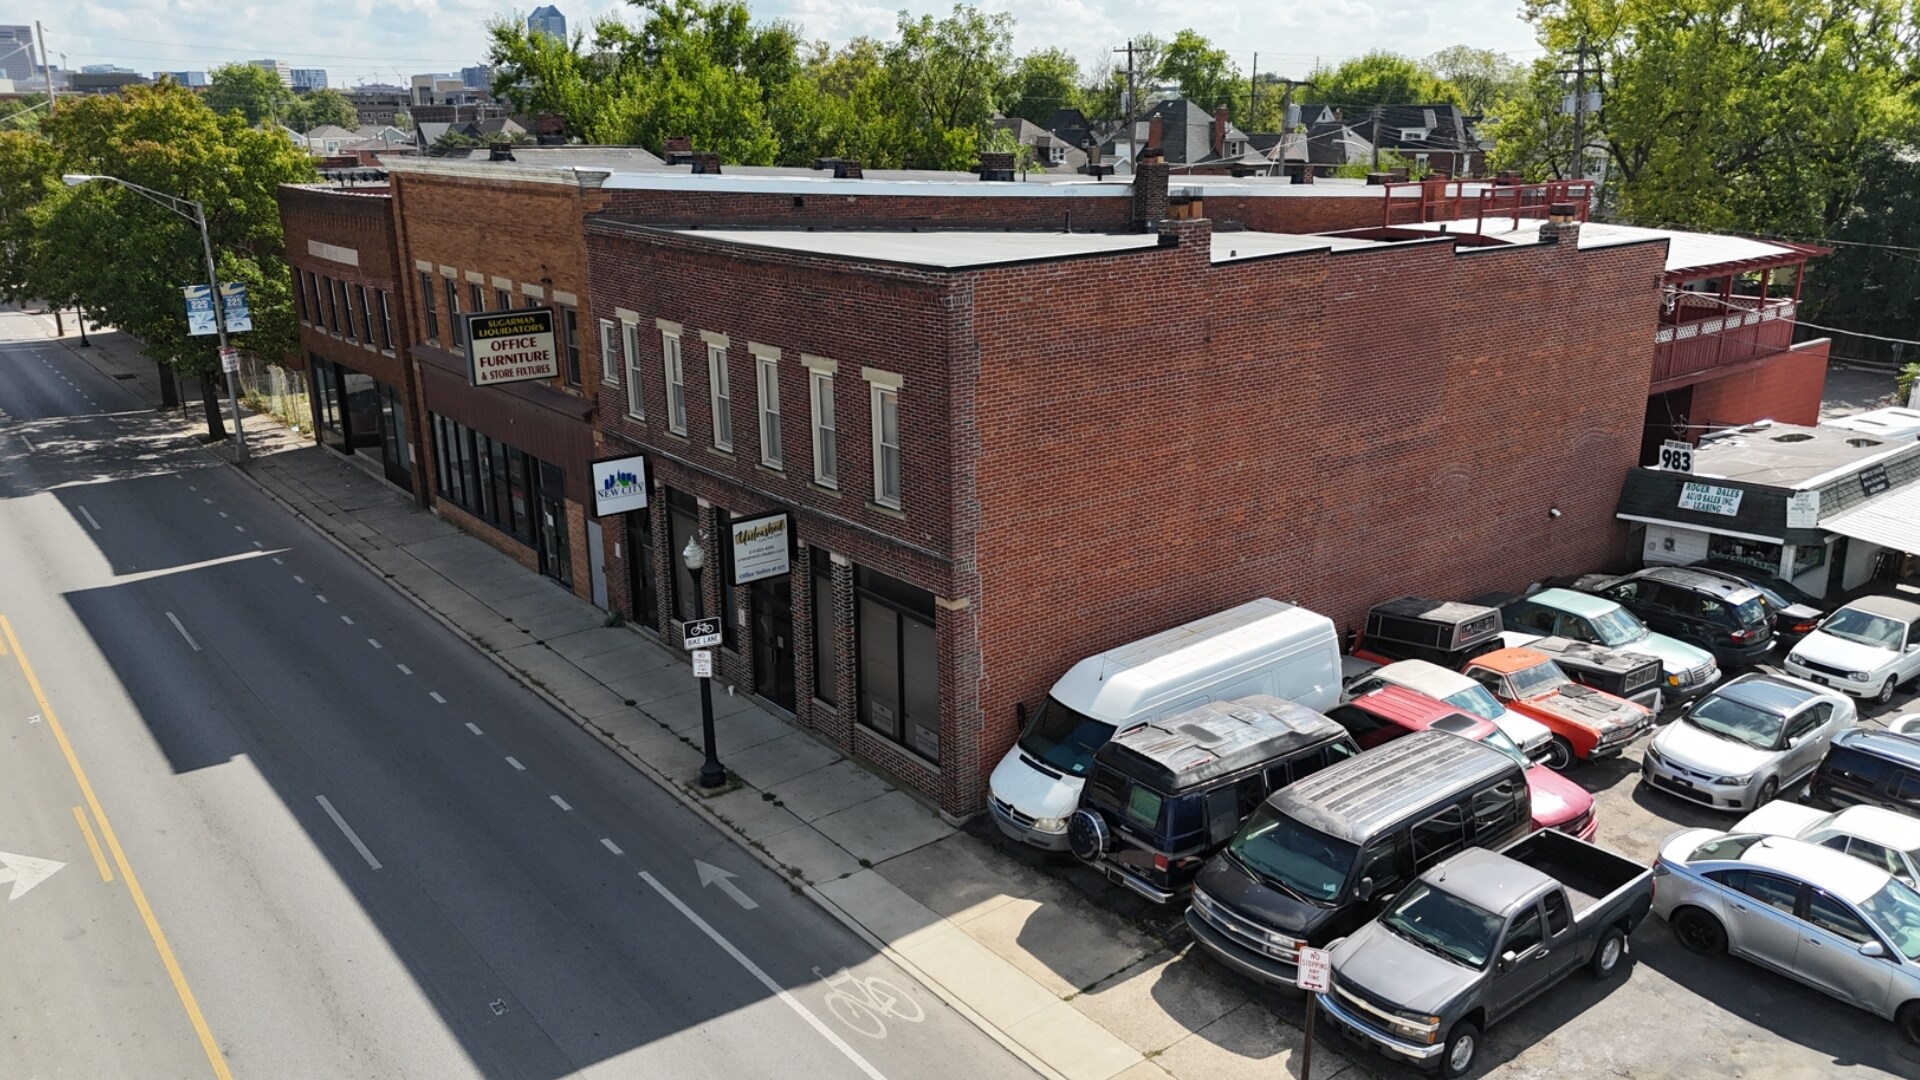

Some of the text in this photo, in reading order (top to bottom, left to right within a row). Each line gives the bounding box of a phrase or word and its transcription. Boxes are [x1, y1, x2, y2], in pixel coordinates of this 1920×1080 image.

[191, 300, 208, 309] 225
[226, 298, 242, 307] 225
[488, 316, 535, 328] SUGARMAN
[479, 323, 544, 337] LIQUIDATORS
[491, 337, 537, 352] OFFICE
[480, 350, 550, 368] FURNITURE
[481, 364, 551, 381] & STORE FIXTURES
[1662, 449, 1691, 472] 983
[598, 483, 644, 498] NEW CITY
[1685, 482, 1740, 498] ROGER DALES
[1685, 492, 1702, 502] AUTO
[1702, 494, 1721, 504] SALES
[1693, 501, 1721, 513] LEASING
[735, 520, 785, 546] Unleashed
[688, 635, 718, 647] BIKE LANE
[1310, 953, 1320, 961] NO
[1302, 959, 1328, 970] STOPPING
